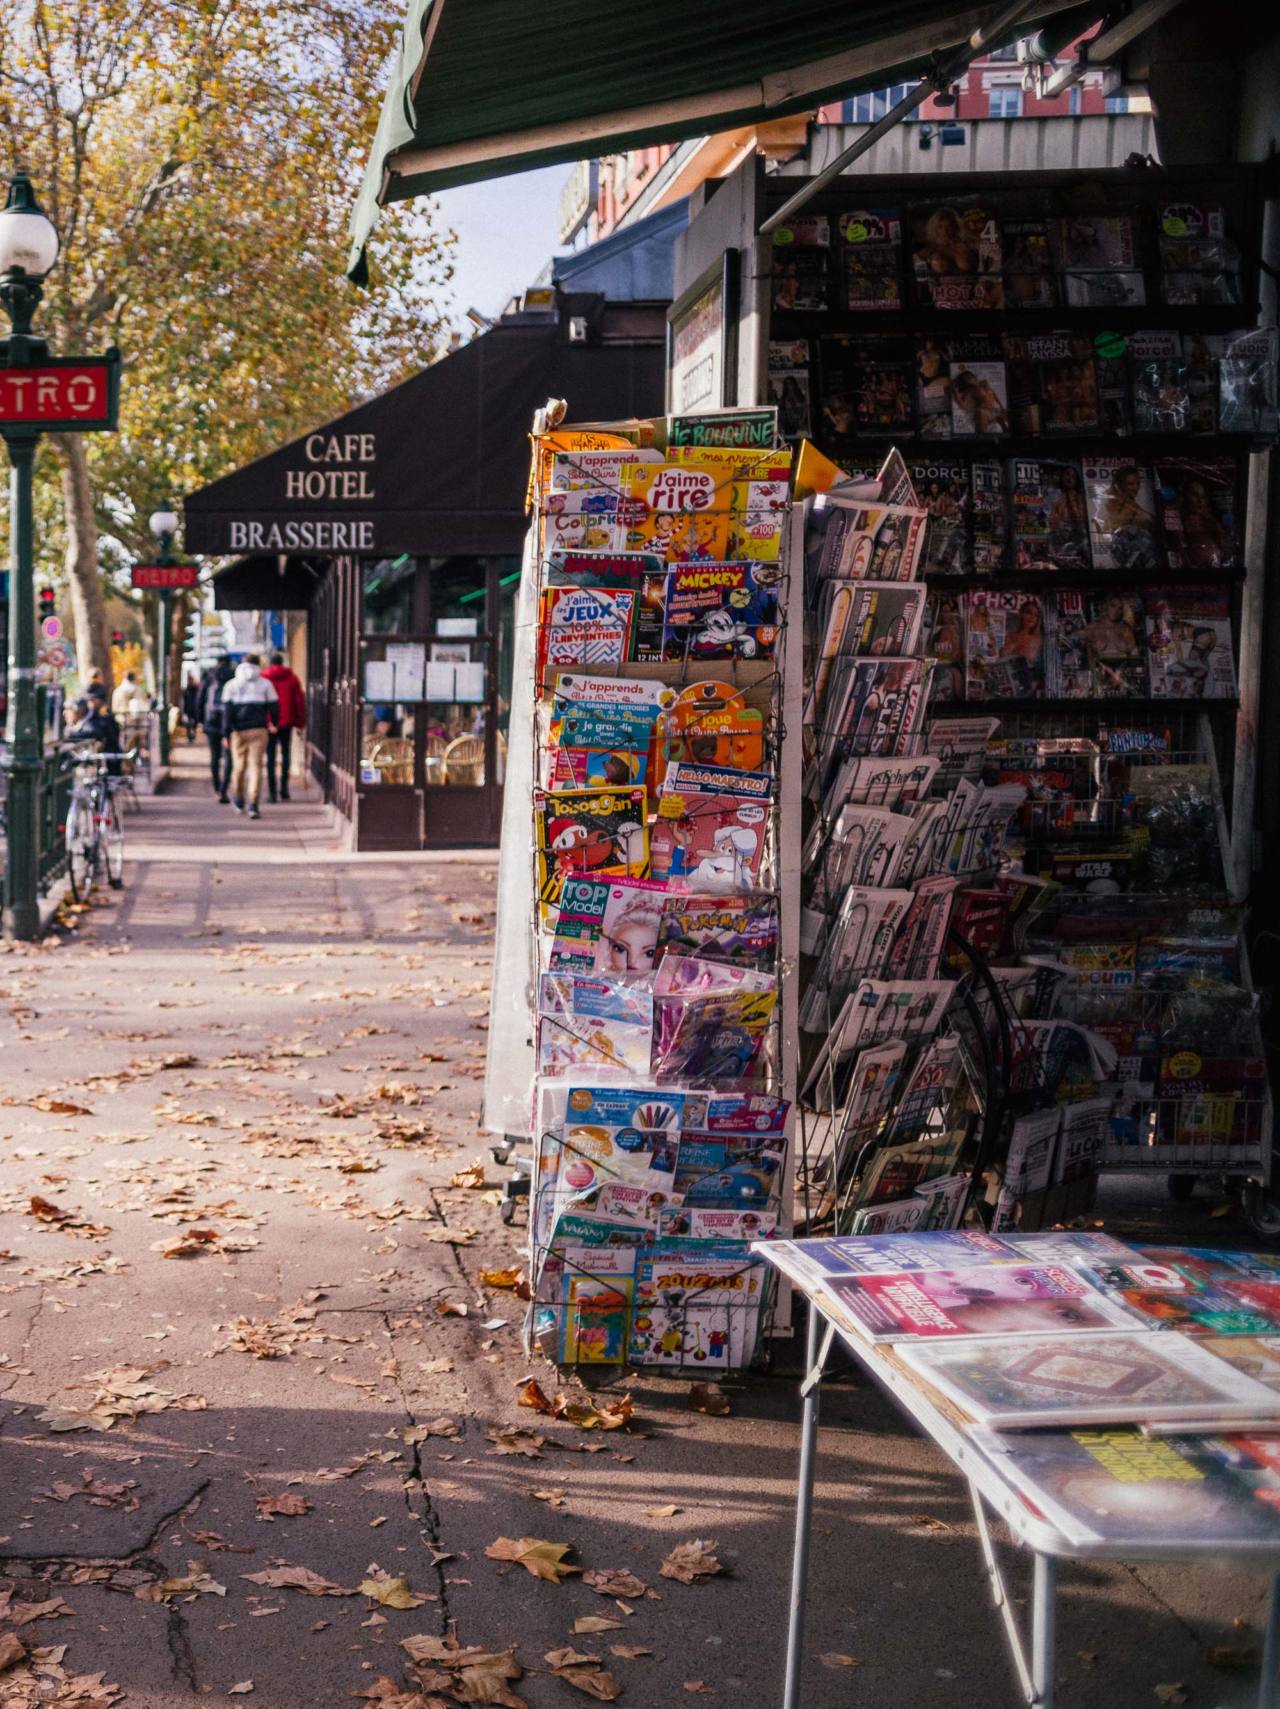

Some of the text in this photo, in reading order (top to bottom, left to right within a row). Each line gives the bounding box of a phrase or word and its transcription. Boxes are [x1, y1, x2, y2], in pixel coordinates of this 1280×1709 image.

[306, 434, 376, 463] CAFE
[286, 471, 375, 499] HOTEL
[654, 473, 710, 488] J'aime
[652, 488, 710, 510] rire
[230, 521, 375, 550] BRASSERIE
[135, 568, 194, 584] METRO
[678, 572, 743, 588] MICKEY
[562, 602, 612, 622] JEUX
[580, 680, 644, 694] J'apprends
[566, 884, 608, 902] TOP
[561, 899, 604, 914] Model
